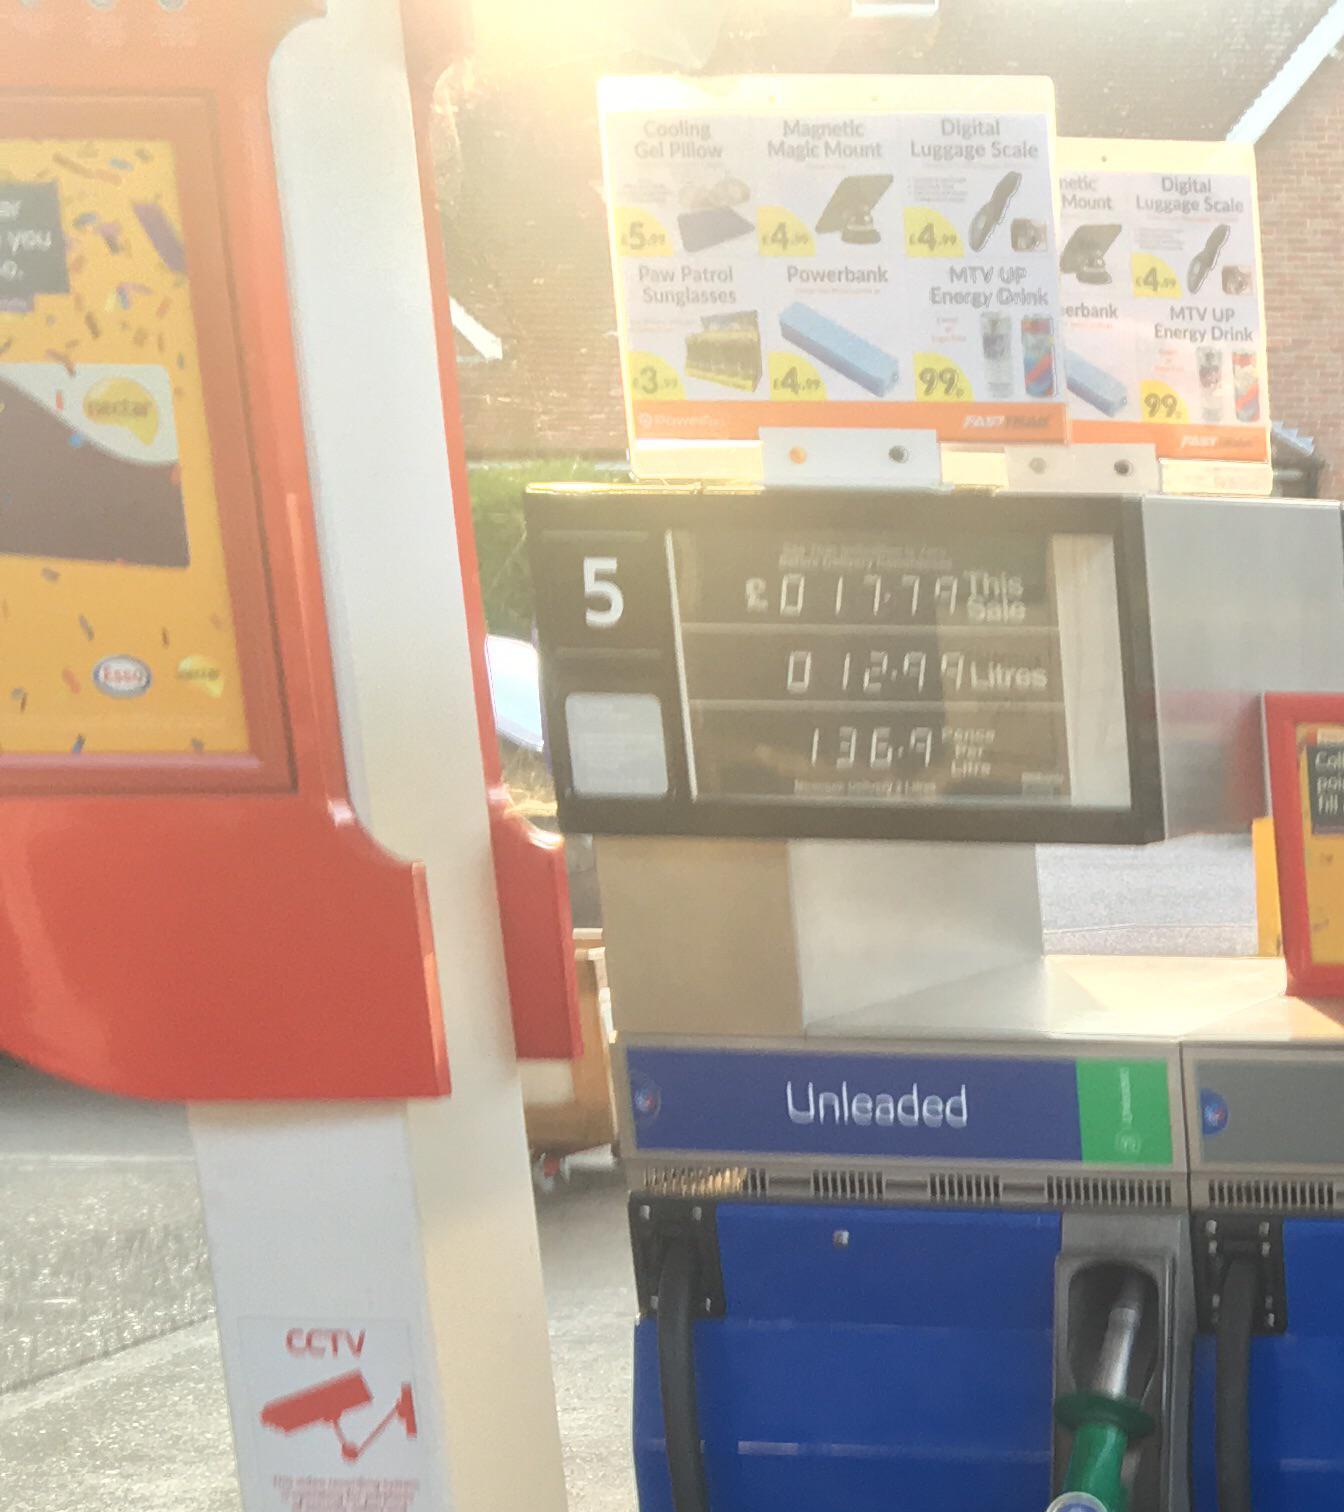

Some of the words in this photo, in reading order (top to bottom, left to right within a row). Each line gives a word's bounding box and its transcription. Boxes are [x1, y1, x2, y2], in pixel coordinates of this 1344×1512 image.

[643, 120, 711, 140] Cooling
[783, 120, 865, 141] Magnetic
[941, 118, 1000, 140] Digital
[634, 141, 664, 159] Gel
[669, 141, 723, 159] Pillow
[767, 141, 819, 161] Magic
[824, 141, 882, 159] Mount
[910, 141, 986, 161] Luggage
[991, 141, 1039, 159] Scale
[1161, 176, 1212, 195] Digital
[1062, 195, 1112, 211] Mount
[1136, 195, 1200, 213] Luggage
[1205, 197, 1244, 213] Scale
[638, 266, 675, 283] Paw
[681, 265, 734, 283] Patrol
[787, 266, 888, 283] Powerbank
[950, 266, 994, 284] MTV
[999, 266, 1027, 284] UP
[643, 287, 736, 307] Sunglasses
[930, 287, 993, 308] Energy
[998, 287, 1048, 306] Drink
[1170, 305, 1207, 322] MTV
[1212, 307, 1235, 323] UP
[1154, 323, 1206, 342] Energy
[1211, 325, 1254, 342] Drink
[583, 556, 624, 628] 5
[971, 661, 1048, 690] Litres
[786, 1080, 968, 1128] Unleaded
[286, 1327, 366, 1360] CCTV
